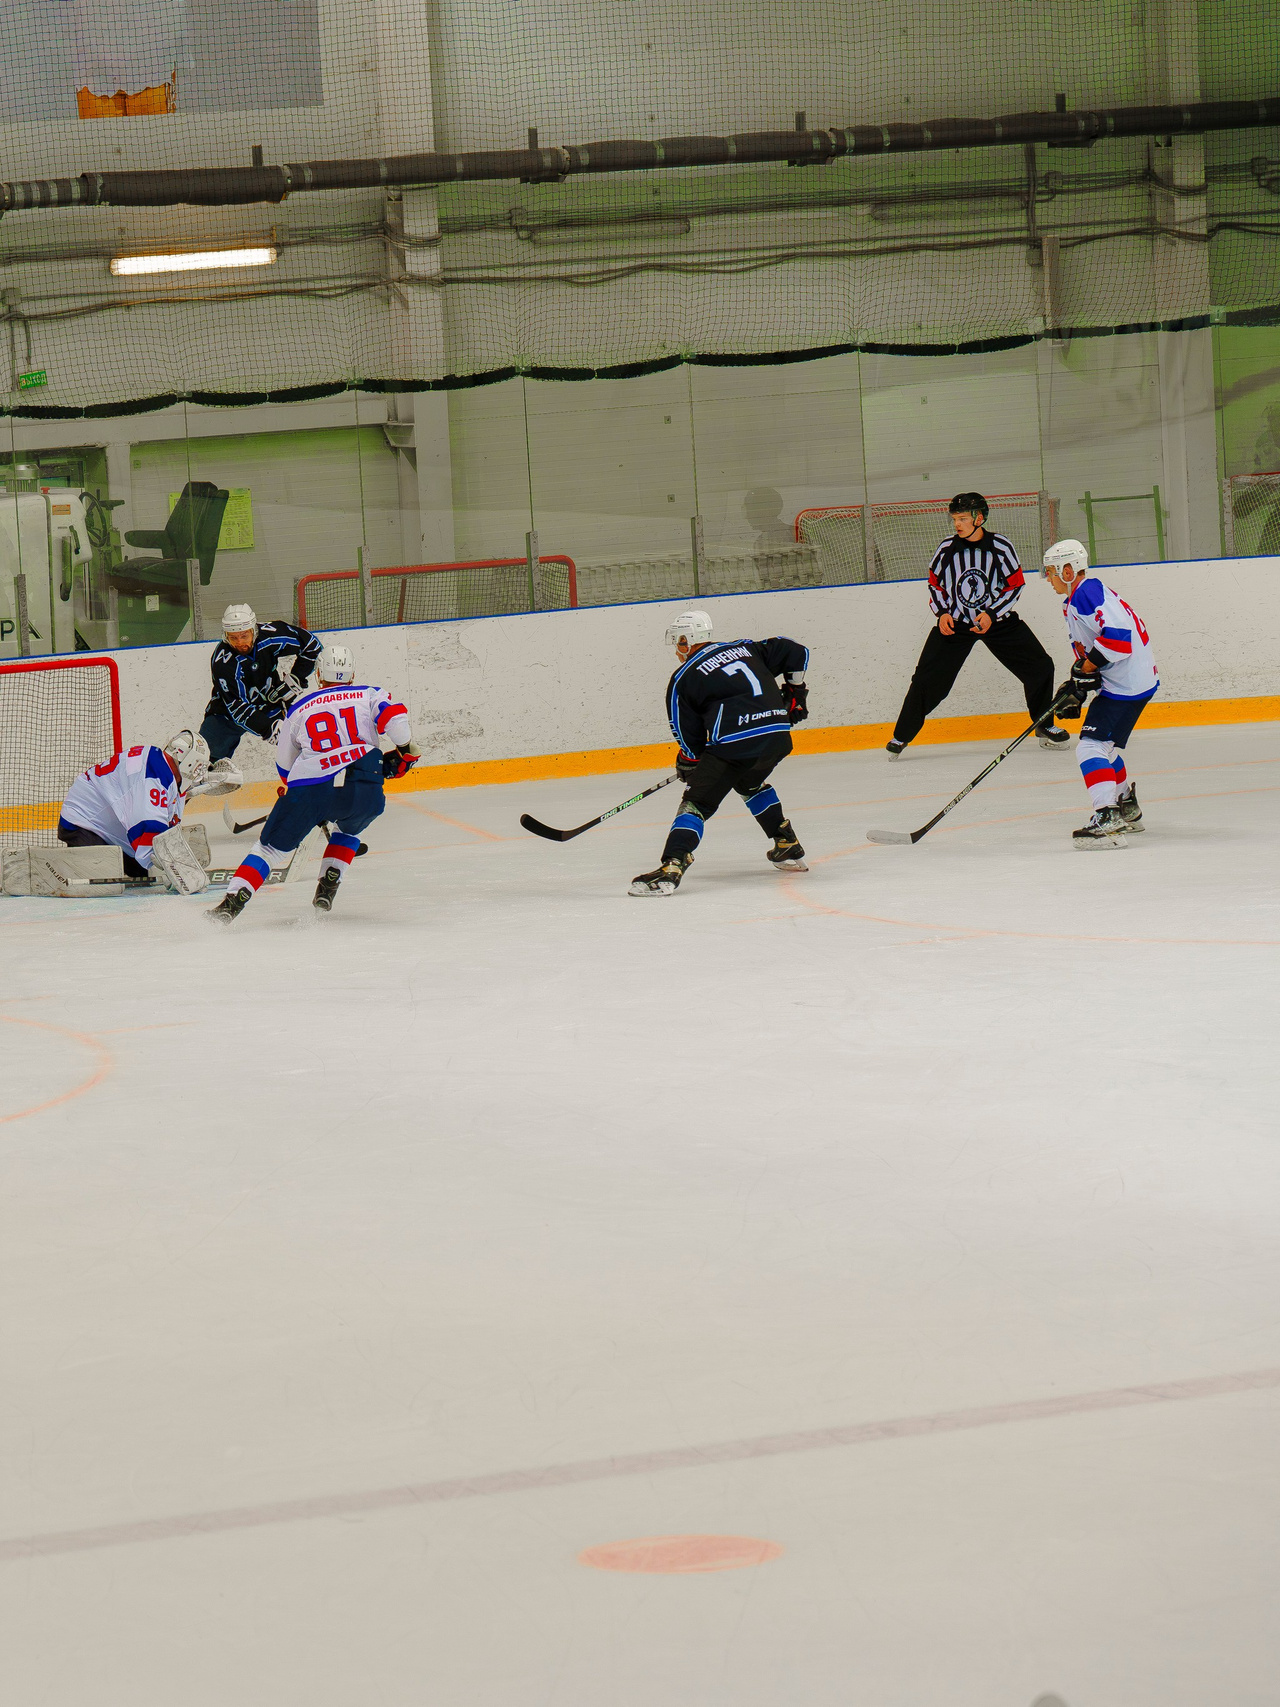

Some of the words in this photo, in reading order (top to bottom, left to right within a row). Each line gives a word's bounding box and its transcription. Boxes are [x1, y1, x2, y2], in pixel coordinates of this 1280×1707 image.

[20, 373, 47, 387] ВЫХОД
[335, 672, 344, 680] 12
[720, 660, 763, 697] 7
[751, 710, 772, 721] ONE
[304, 705, 367, 753] 81
[319, 746, 368, 771] SOCHI
[149, 788, 169, 808] 92
